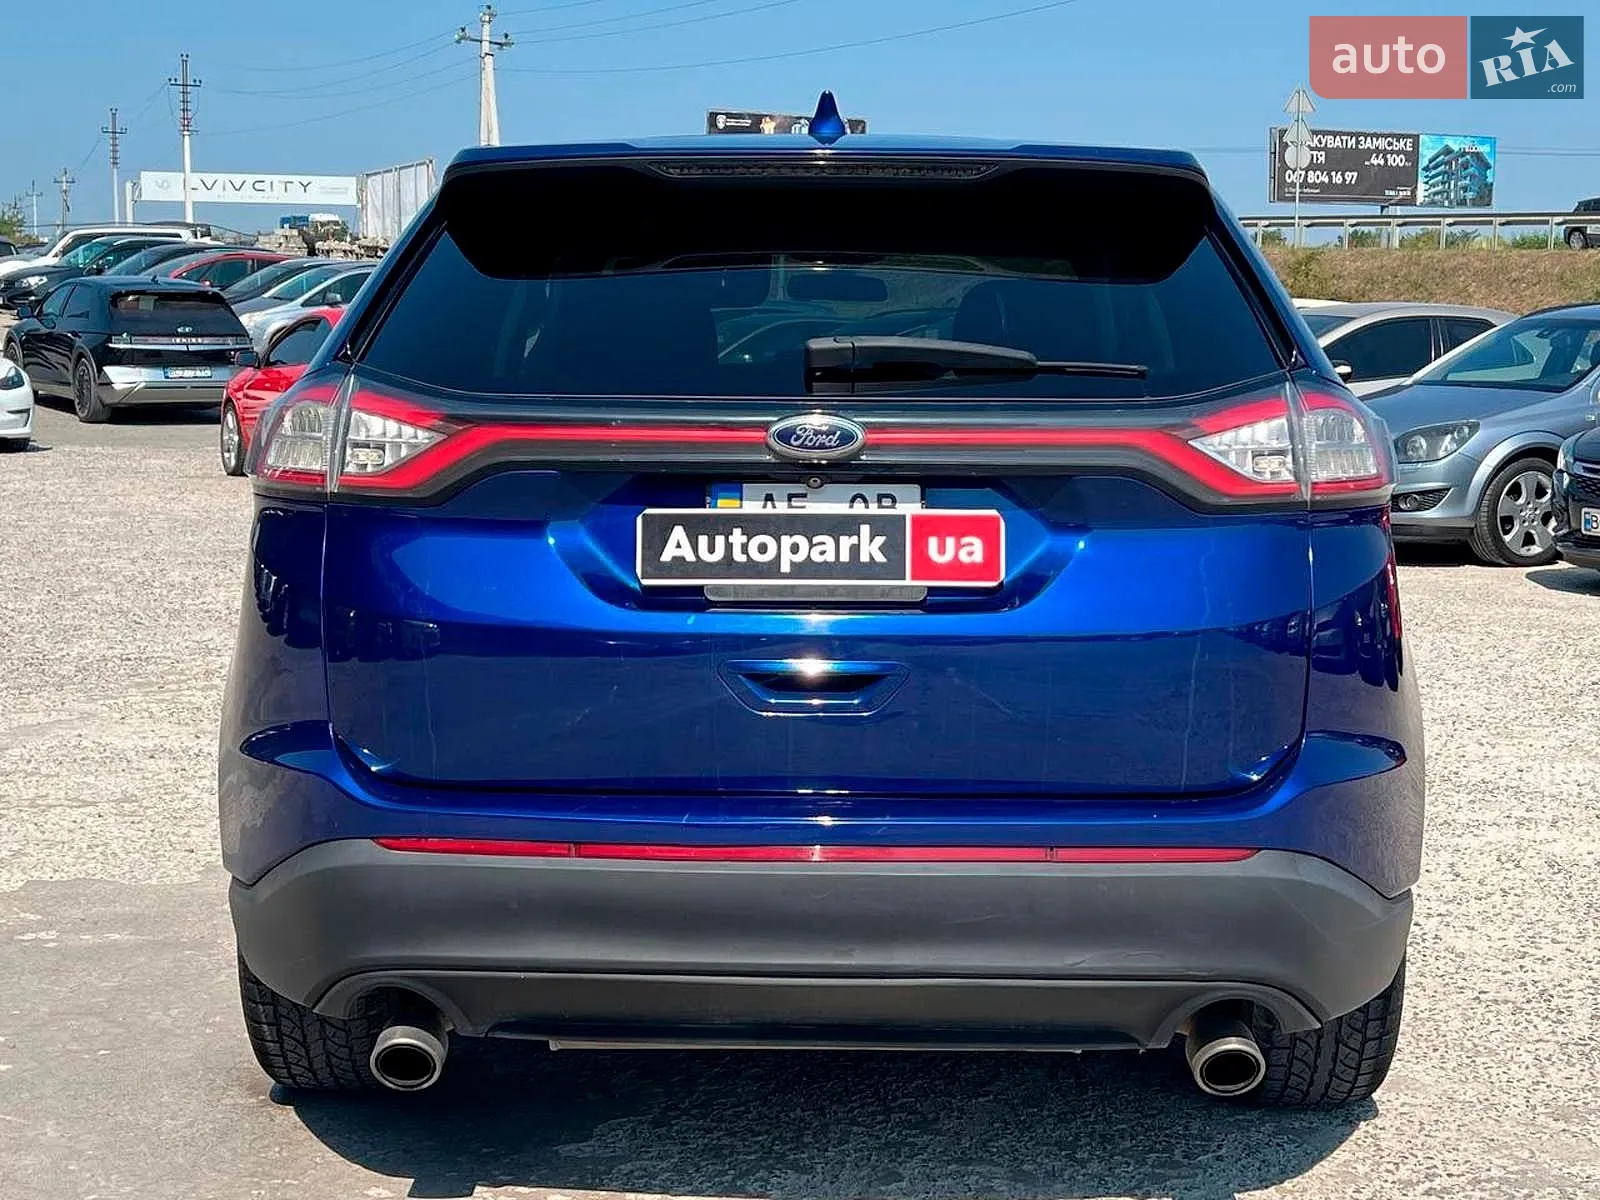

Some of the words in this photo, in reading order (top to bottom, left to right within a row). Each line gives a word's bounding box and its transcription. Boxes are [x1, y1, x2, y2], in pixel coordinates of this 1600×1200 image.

[1358, 136, 1413, 151] ЗАМІСЬКЕ
[1370, 153, 1385, 167] 44
[1387, 153, 1405, 167] 100
[1307, 170, 1330, 184] 804
[1331, 171, 1343, 184] 16
[1344, 171, 1358, 184] 97
[790, 423, 840, 448] Ford
[659, 524, 888, 573] Autopark
[927, 534, 985, 565] ua
